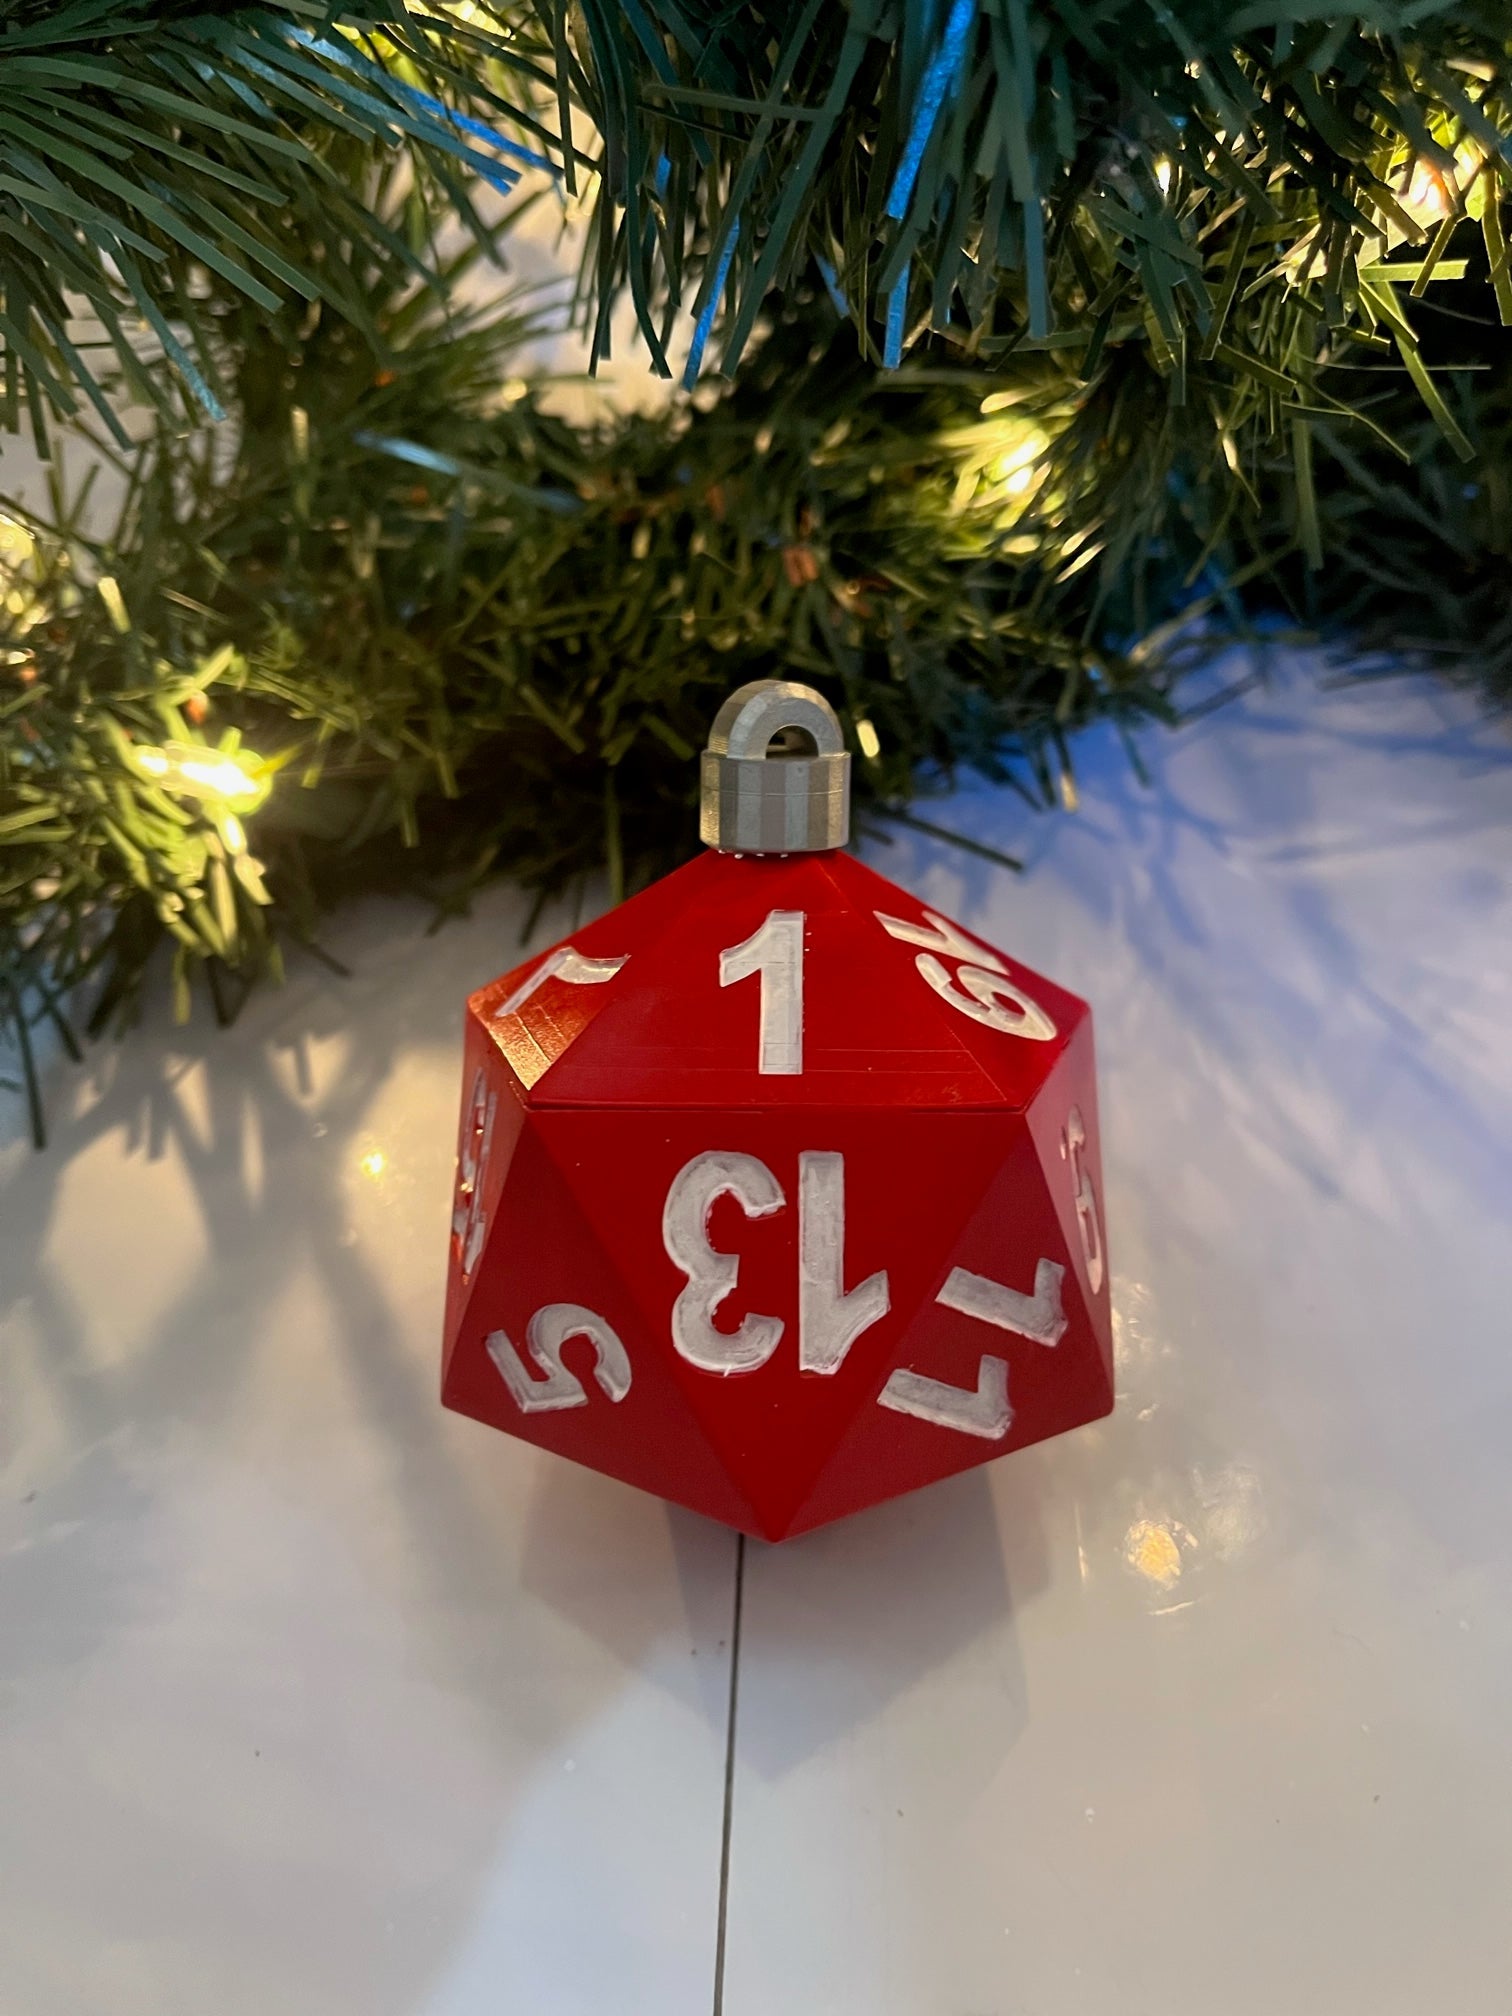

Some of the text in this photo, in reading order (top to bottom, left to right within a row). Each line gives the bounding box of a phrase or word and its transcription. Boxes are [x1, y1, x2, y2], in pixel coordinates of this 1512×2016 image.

[719, 909, 806, 1075] 1
[873, 911, 1056, 1041] 19
[662, 1150, 892, 1376] 13
[485, 1303, 632, 1413] 5
[877, 1257, 1068, 1440] 11
